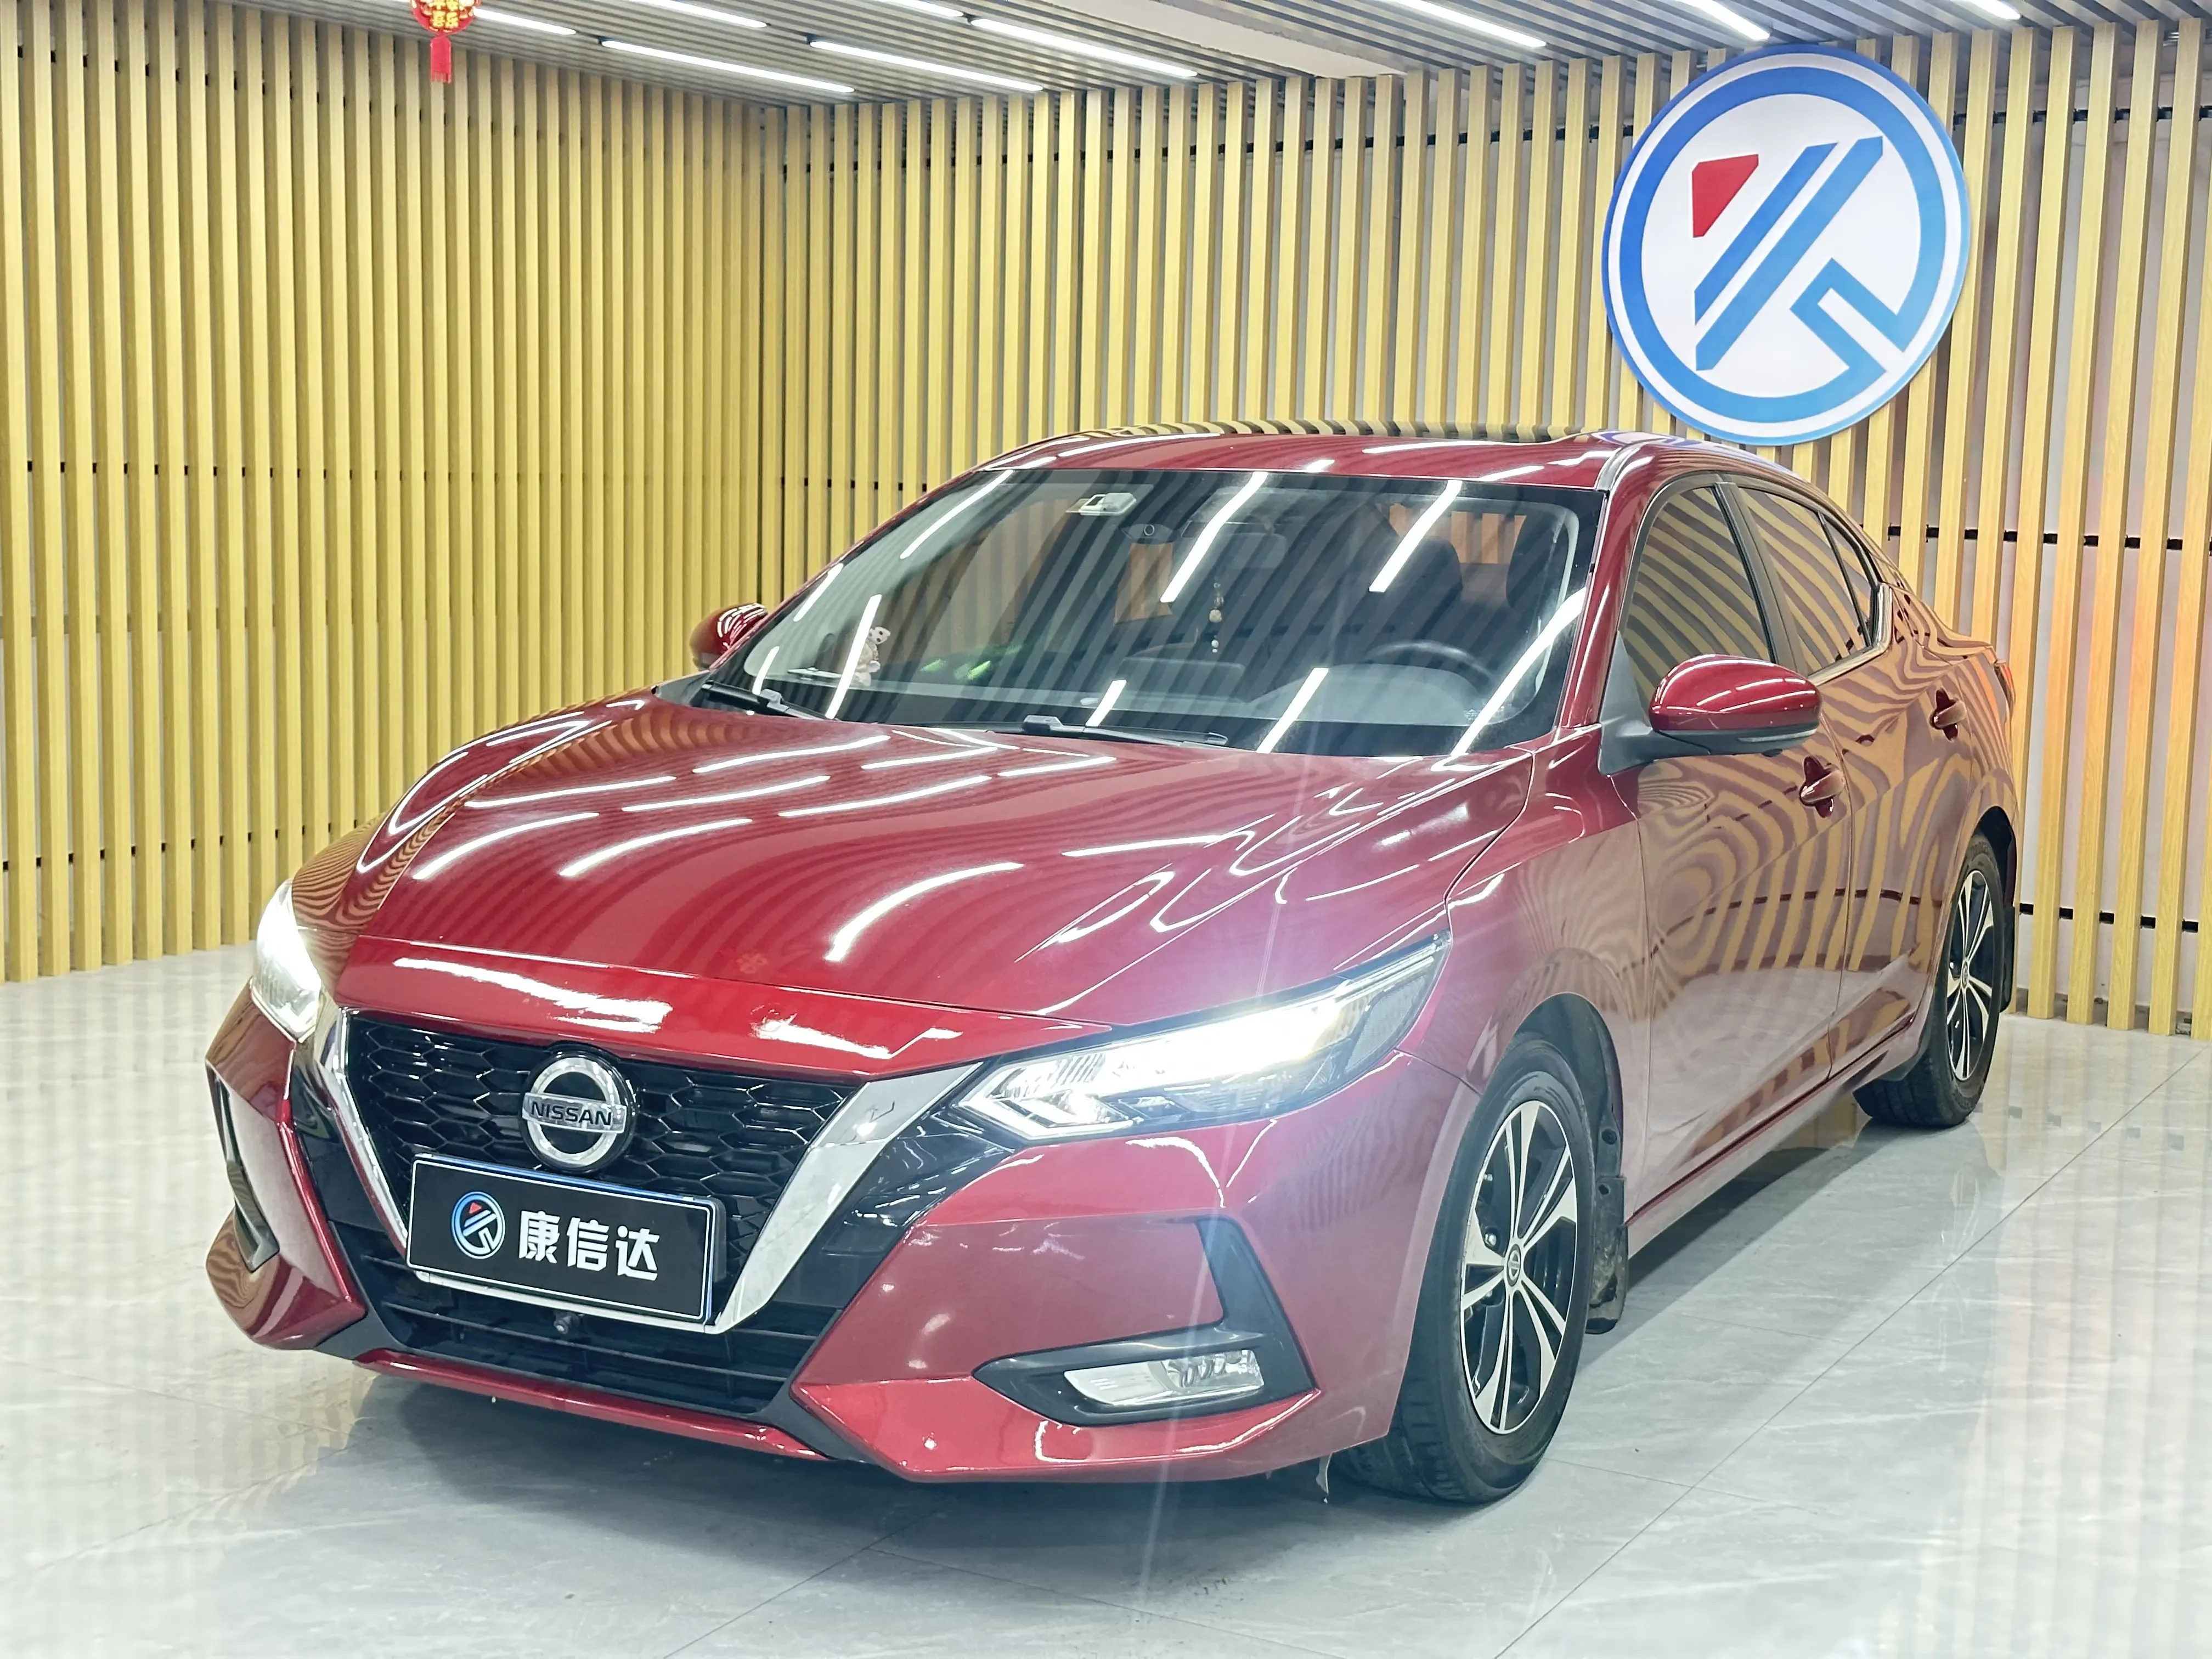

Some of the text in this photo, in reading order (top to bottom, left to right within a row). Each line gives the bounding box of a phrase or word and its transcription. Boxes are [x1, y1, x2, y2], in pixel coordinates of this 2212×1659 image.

[531, 1101, 612, 1126] NISSAN
[518, 1211, 660, 1281] 康信达
